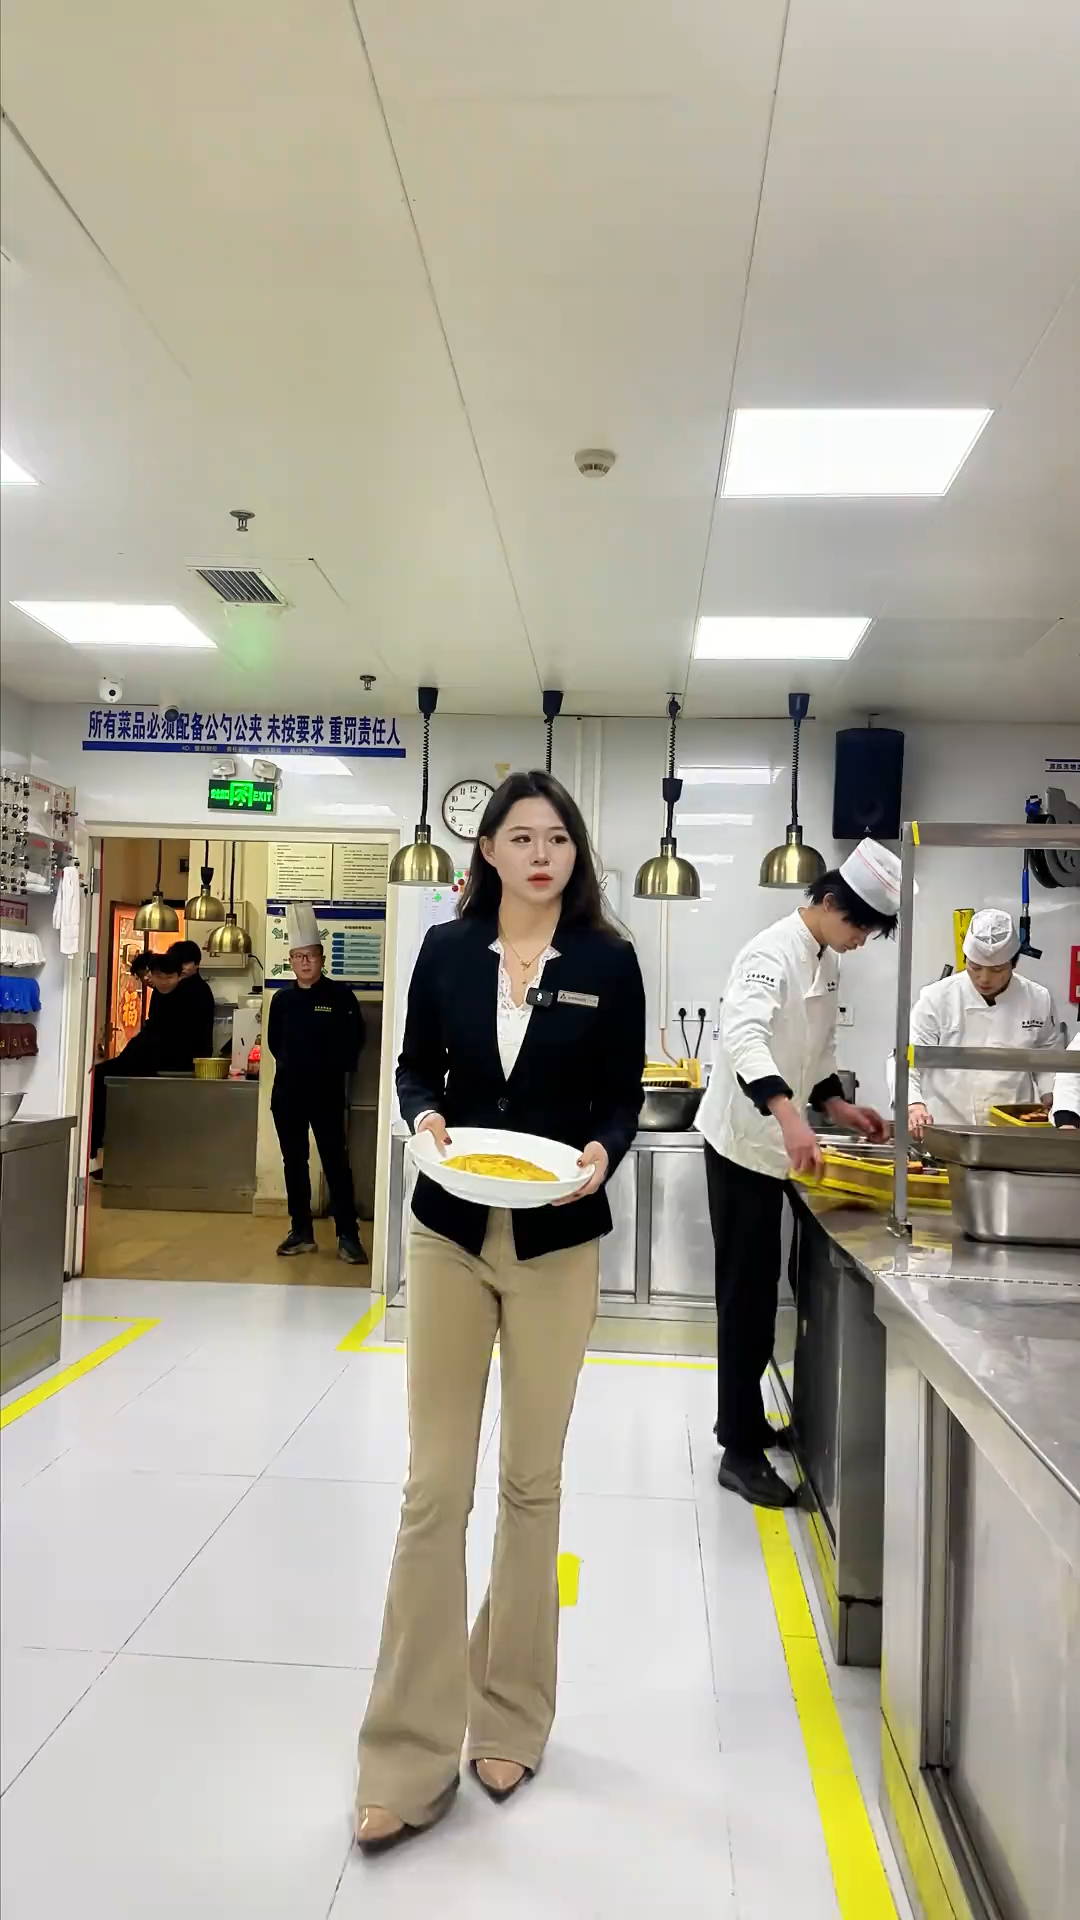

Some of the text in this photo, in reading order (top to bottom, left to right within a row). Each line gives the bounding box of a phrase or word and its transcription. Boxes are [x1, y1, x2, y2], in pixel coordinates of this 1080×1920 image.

[88, 710, 400, 746] 所有菜品必须配备公勺公夹 未按要求 重罚责任人
[470, 785, 478, 793] 12
[253, 790, 273, 802] EXIT
[450, 816, 456, 824] 8
